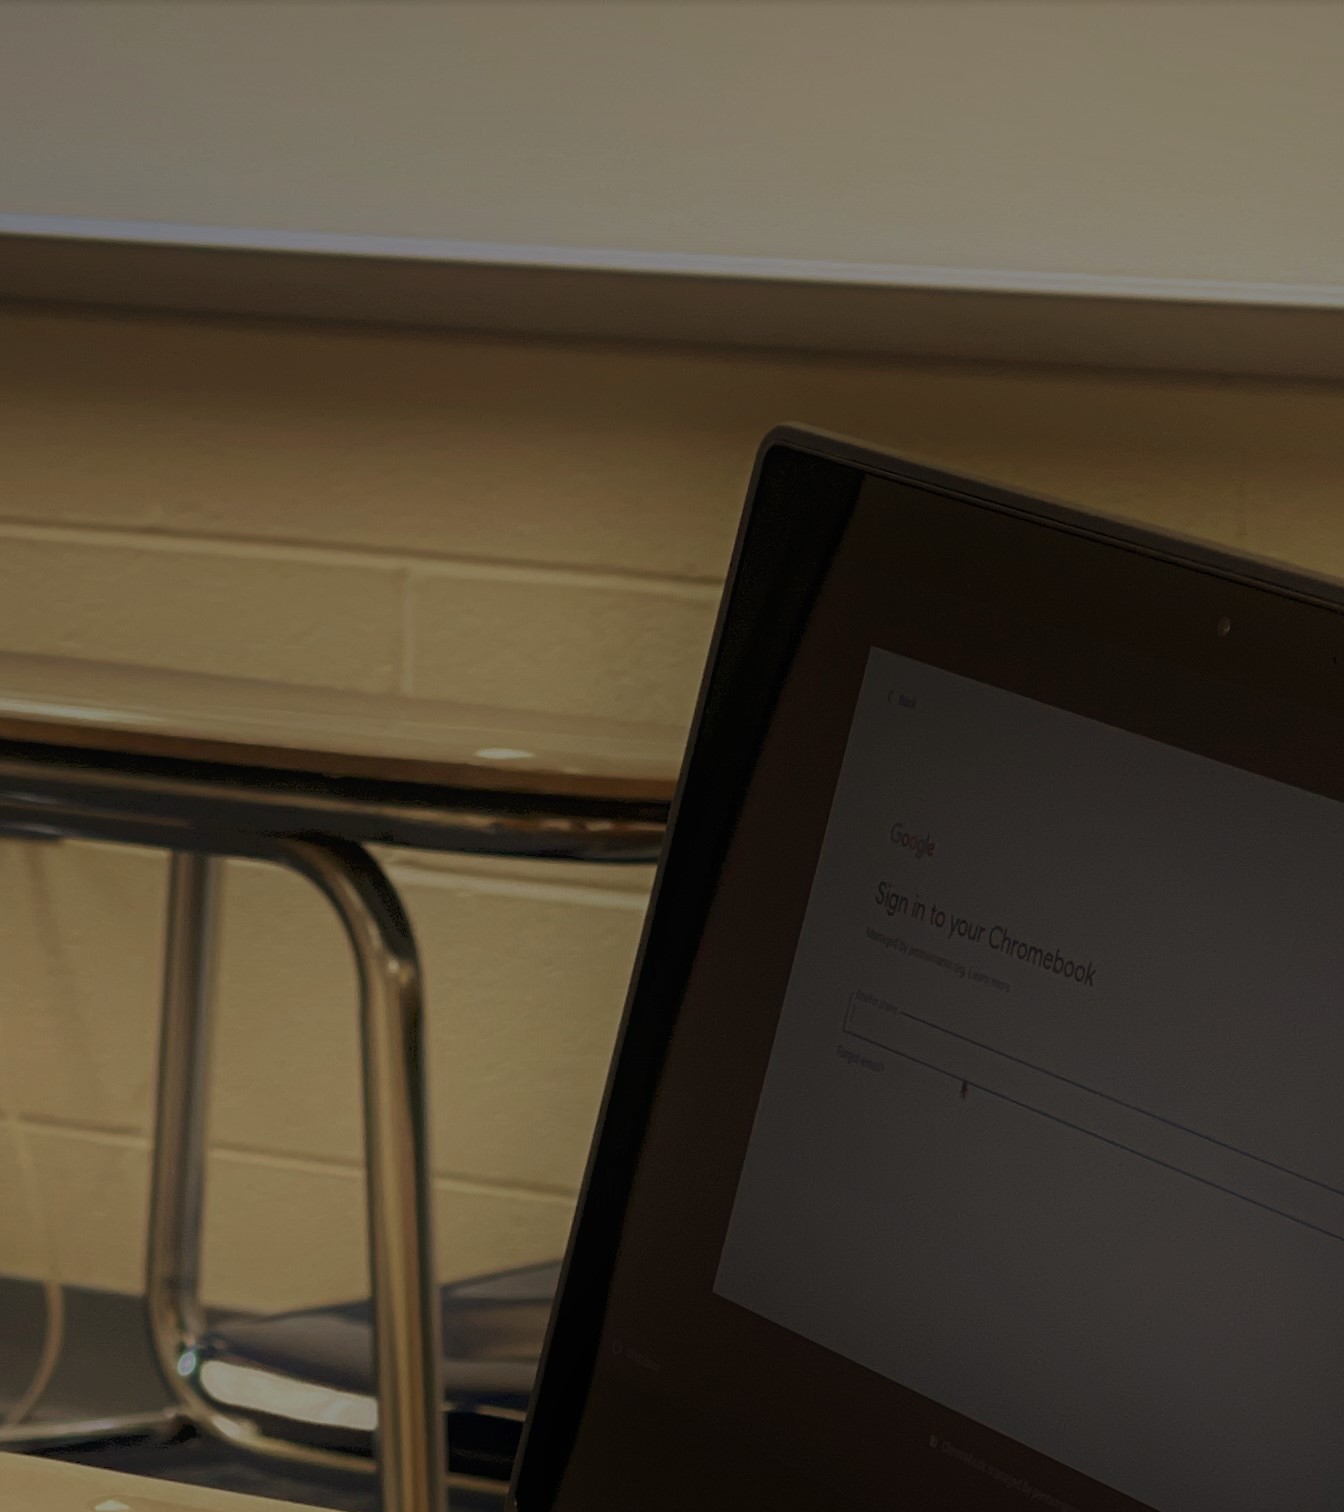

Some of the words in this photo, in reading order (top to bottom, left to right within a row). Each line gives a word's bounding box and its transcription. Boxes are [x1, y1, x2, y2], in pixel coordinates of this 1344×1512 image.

[890, 822, 936, 859] Google
[874, 881, 909, 917] Sign
[911, 894, 927, 920] in
[930, 903, 946, 928] to
[949, 914, 987, 944] your
[988, 924, 1097, 986] Chromebook
